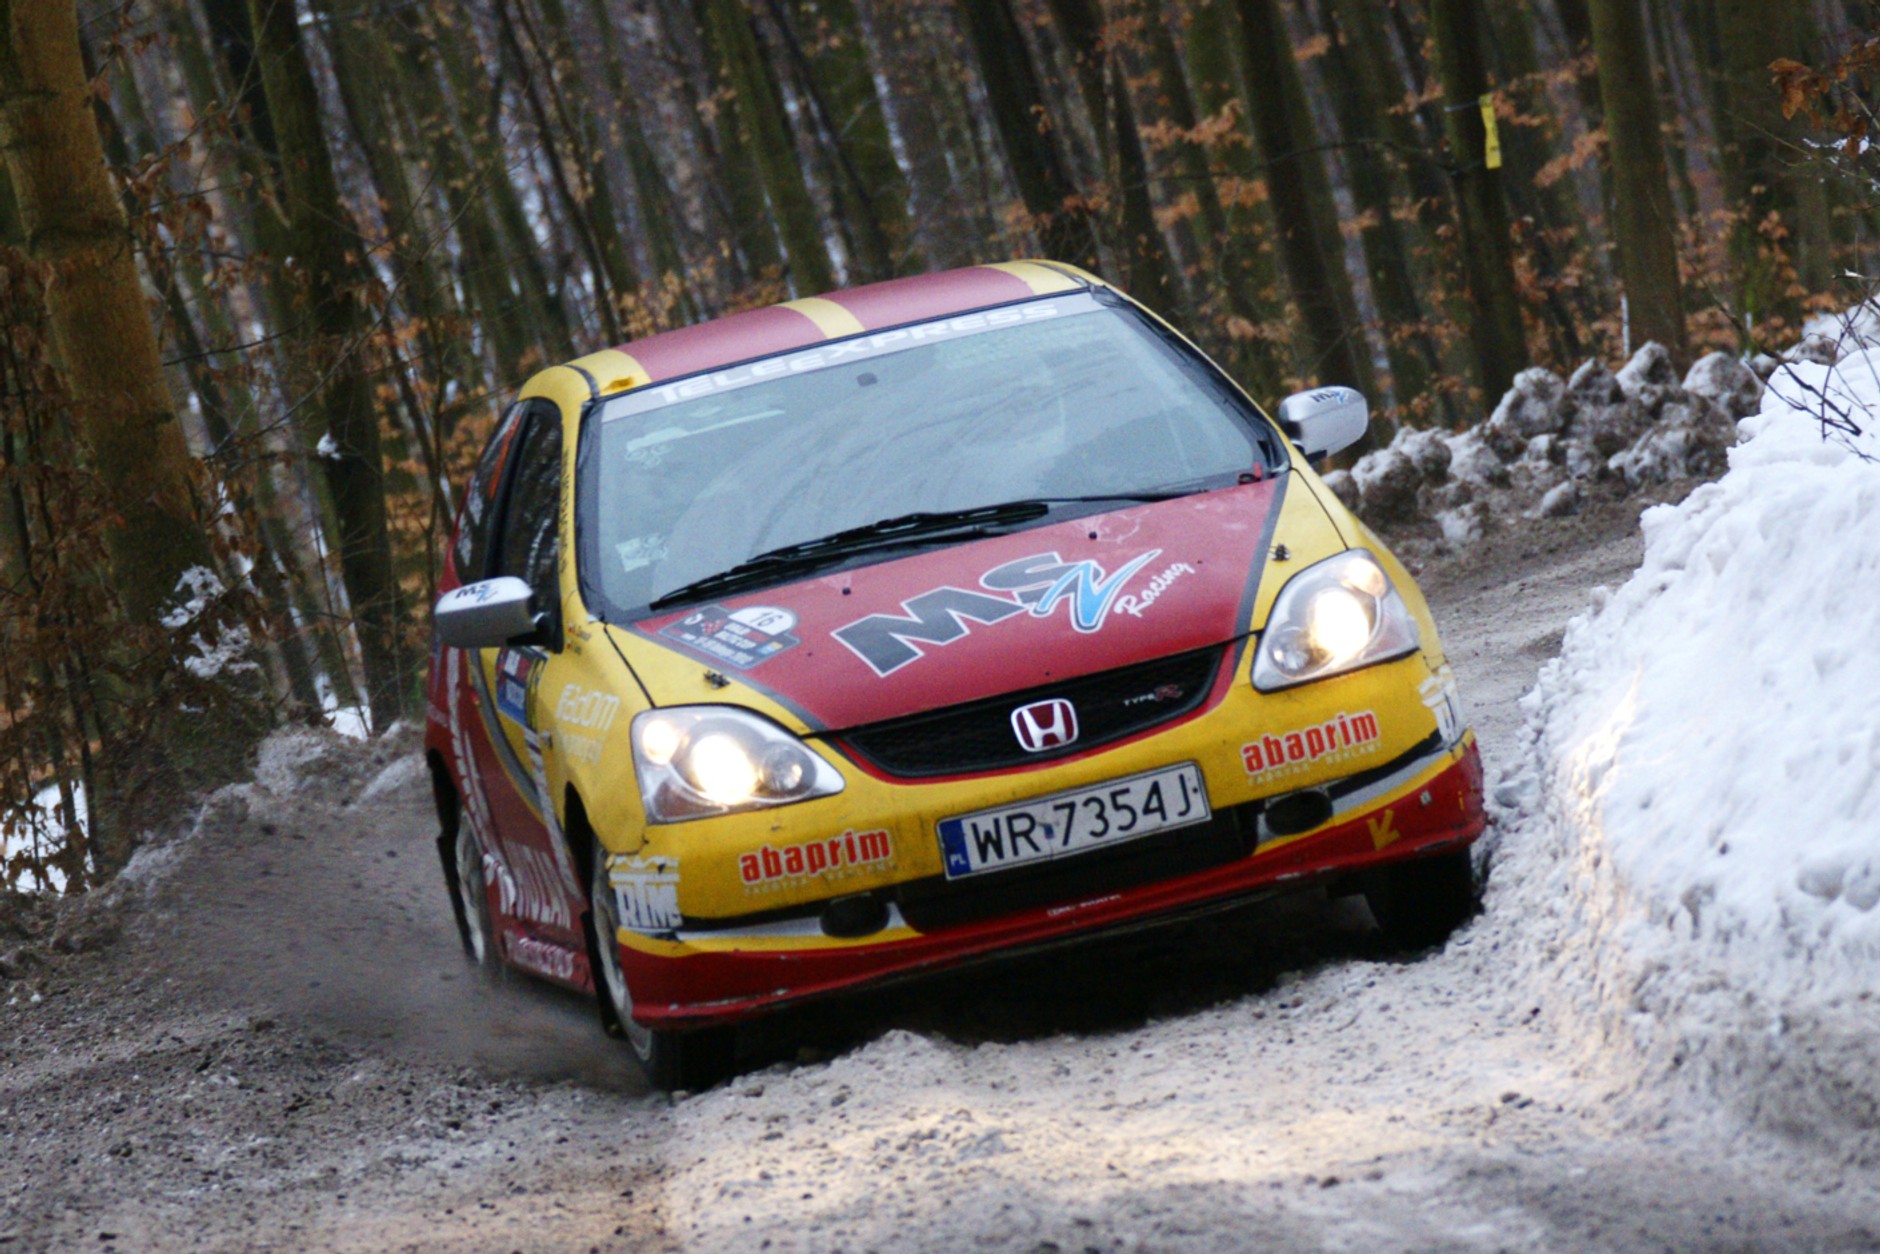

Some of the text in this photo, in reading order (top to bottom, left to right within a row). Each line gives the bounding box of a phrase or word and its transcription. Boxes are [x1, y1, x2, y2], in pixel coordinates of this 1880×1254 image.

[1113, 562, 1196, 618] Racing
[1241, 710, 1379, 775] abaprim
[971, 773, 1192, 864] WR 7354J
[739, 829, 891, 883] abaprim
[949, 855, 967, 867] PL
